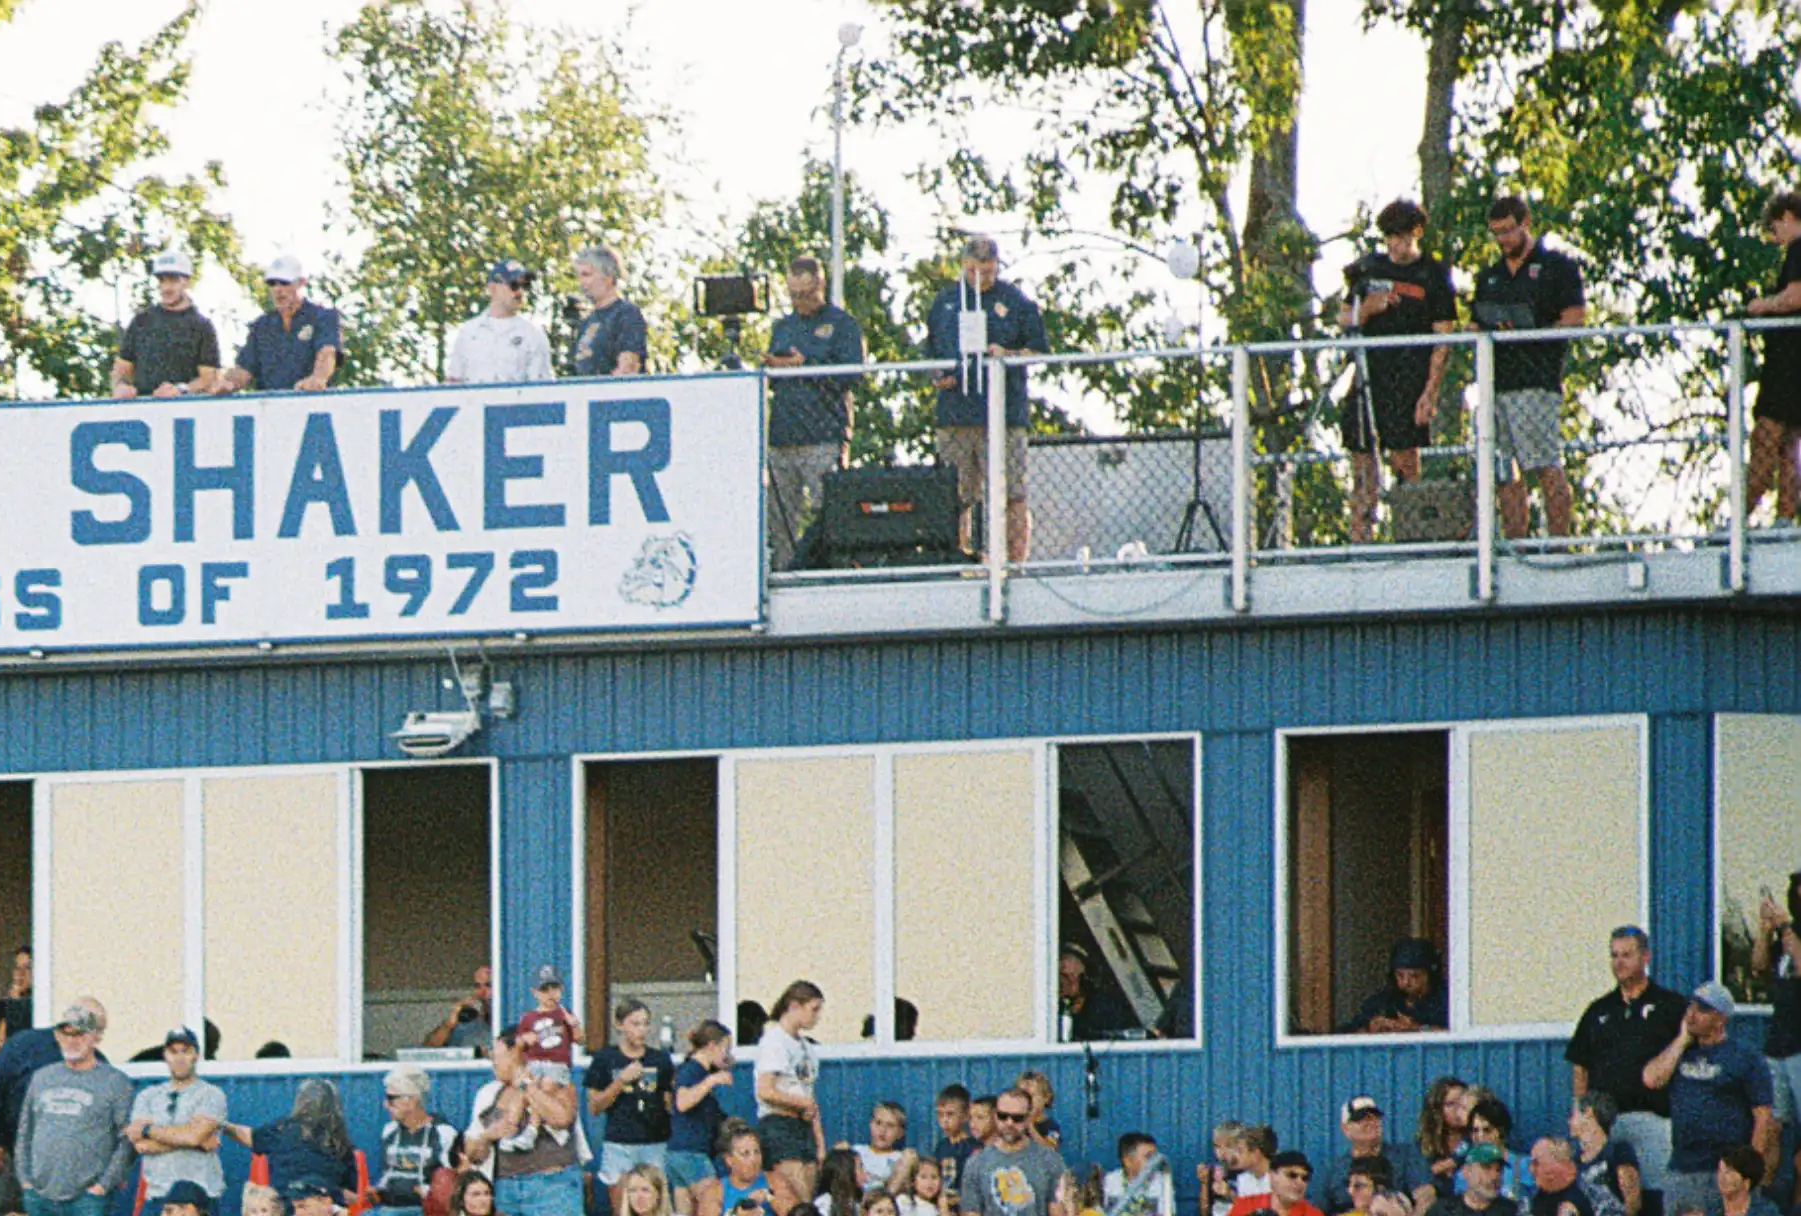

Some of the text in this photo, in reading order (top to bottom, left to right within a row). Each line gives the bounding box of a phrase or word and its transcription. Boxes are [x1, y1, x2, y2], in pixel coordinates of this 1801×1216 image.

[71, 398, 671, 545] SHAKER
[138, 562, 248, 626] OF
[326, 550, 558, 619] 1972
